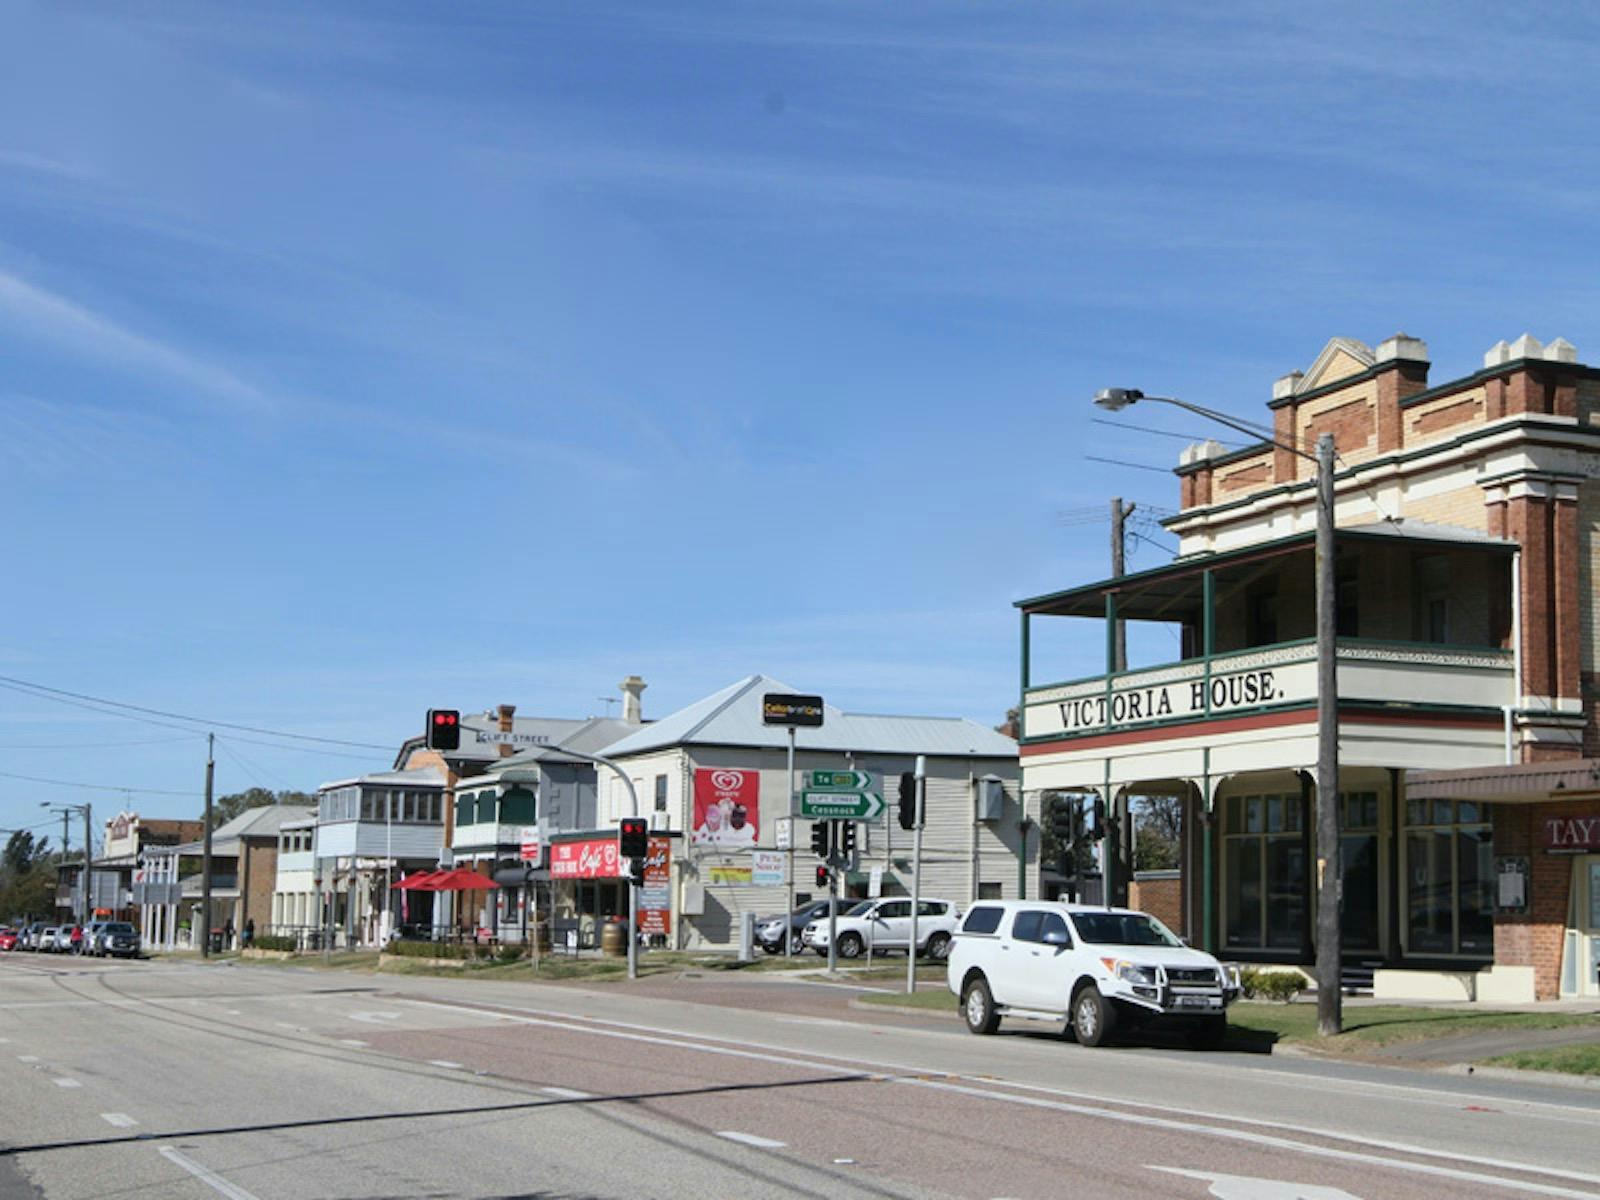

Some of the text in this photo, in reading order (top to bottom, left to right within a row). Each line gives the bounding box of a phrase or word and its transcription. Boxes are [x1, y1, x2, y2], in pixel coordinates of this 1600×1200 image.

[1059, 687, 1173, 728] VICTORIA
[512, 734, 550, 743] STREET
[1546, 819, 1600, 845] TAY
